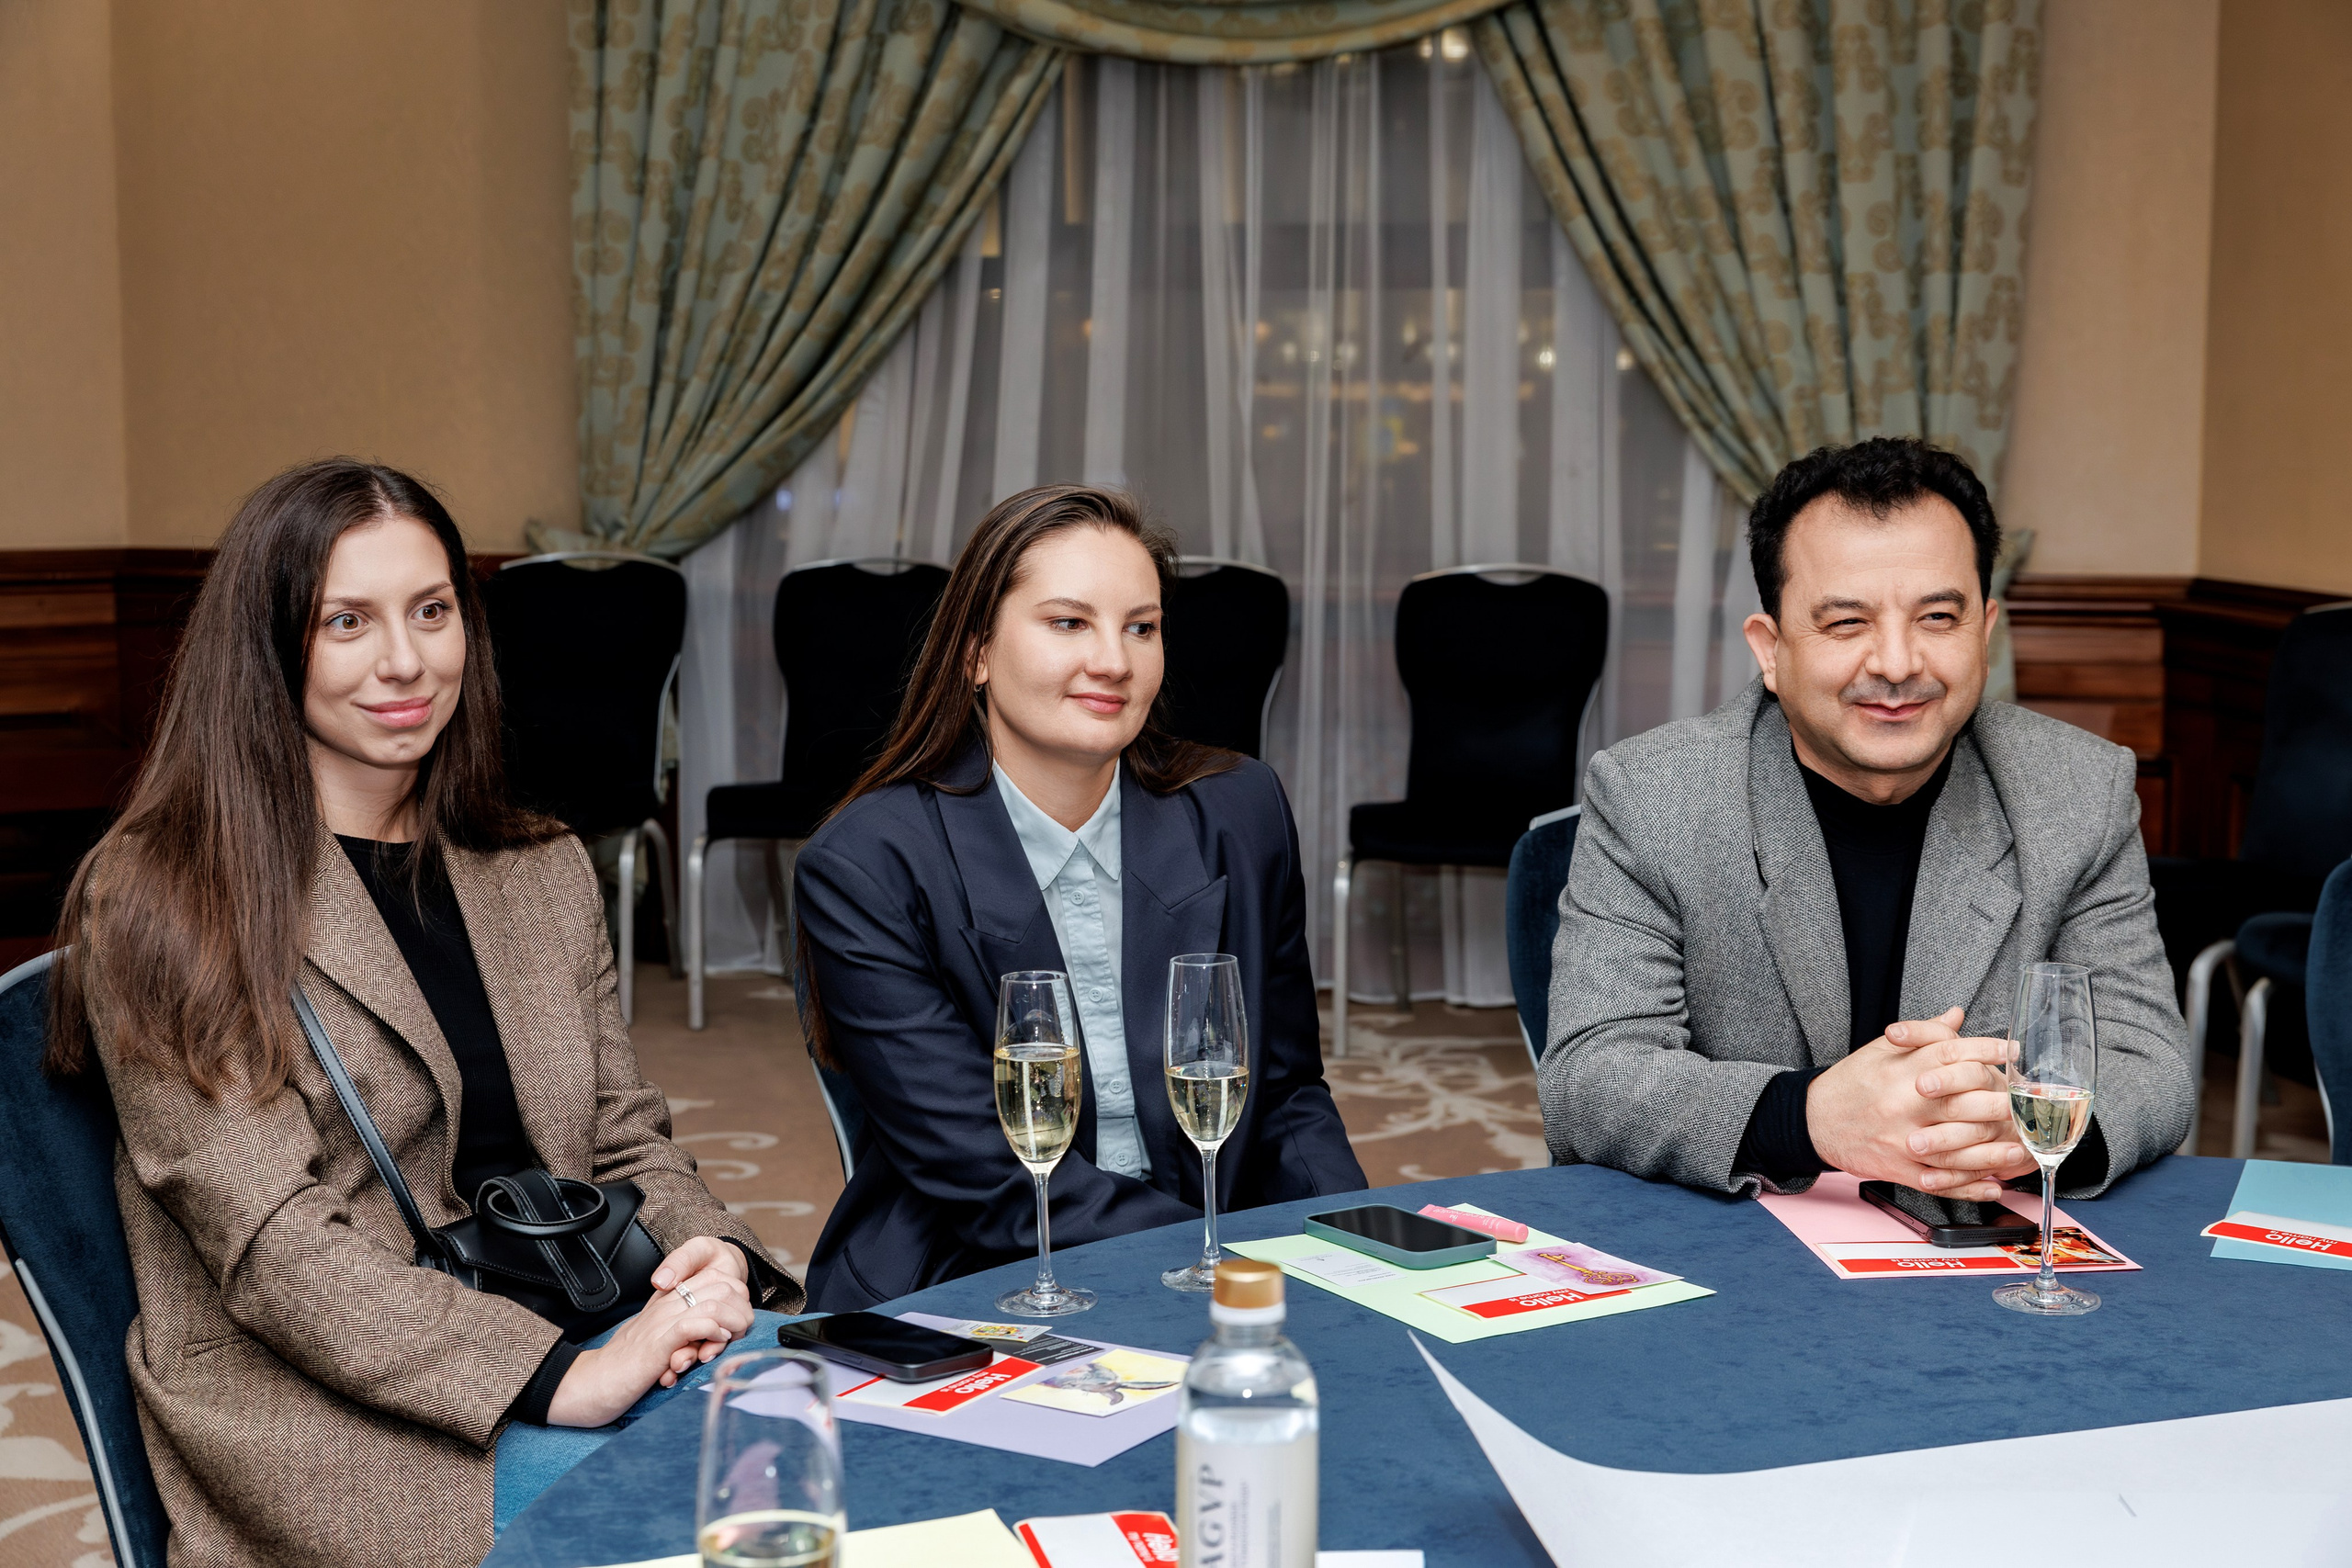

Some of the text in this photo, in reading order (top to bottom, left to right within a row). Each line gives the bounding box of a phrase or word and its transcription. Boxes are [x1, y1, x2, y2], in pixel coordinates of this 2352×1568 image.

[2265, 1234, 2332, 1250] Hello
[2281, 1232, 2316, 1240] name
[1519, 1292, 1584, 1306] Hello
[1520, 1292, 1551, 1300] name
[955, 1373, 1012, 1393] Hello
